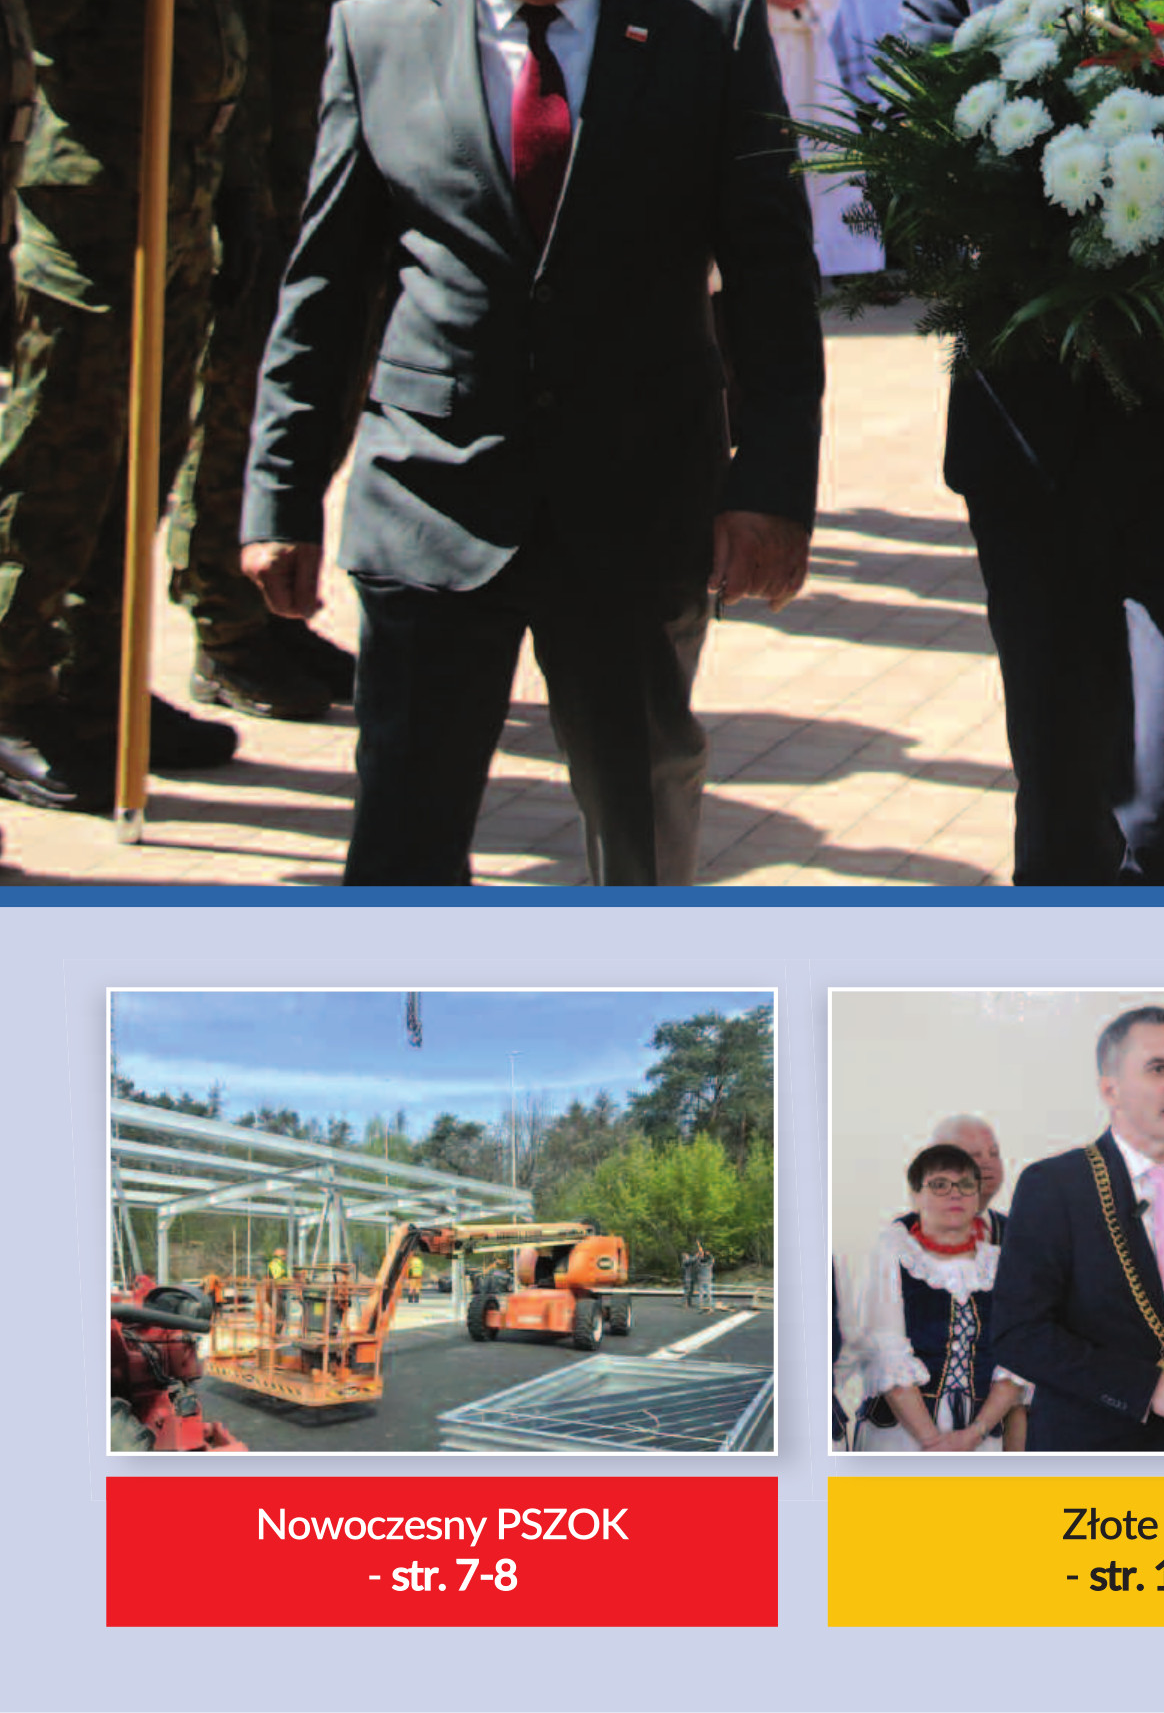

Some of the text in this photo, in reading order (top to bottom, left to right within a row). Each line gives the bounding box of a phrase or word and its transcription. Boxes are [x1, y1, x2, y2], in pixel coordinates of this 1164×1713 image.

[258, 1507, 630, 1548] Nowoczesny PSZOK
[1062, 1507, 1159, 1541] Złote
[391, 1560, 447, 1592] str.
[455, 1557, 518, 1592] 7-8
[1089, 1560, 1145, 1592] str.
